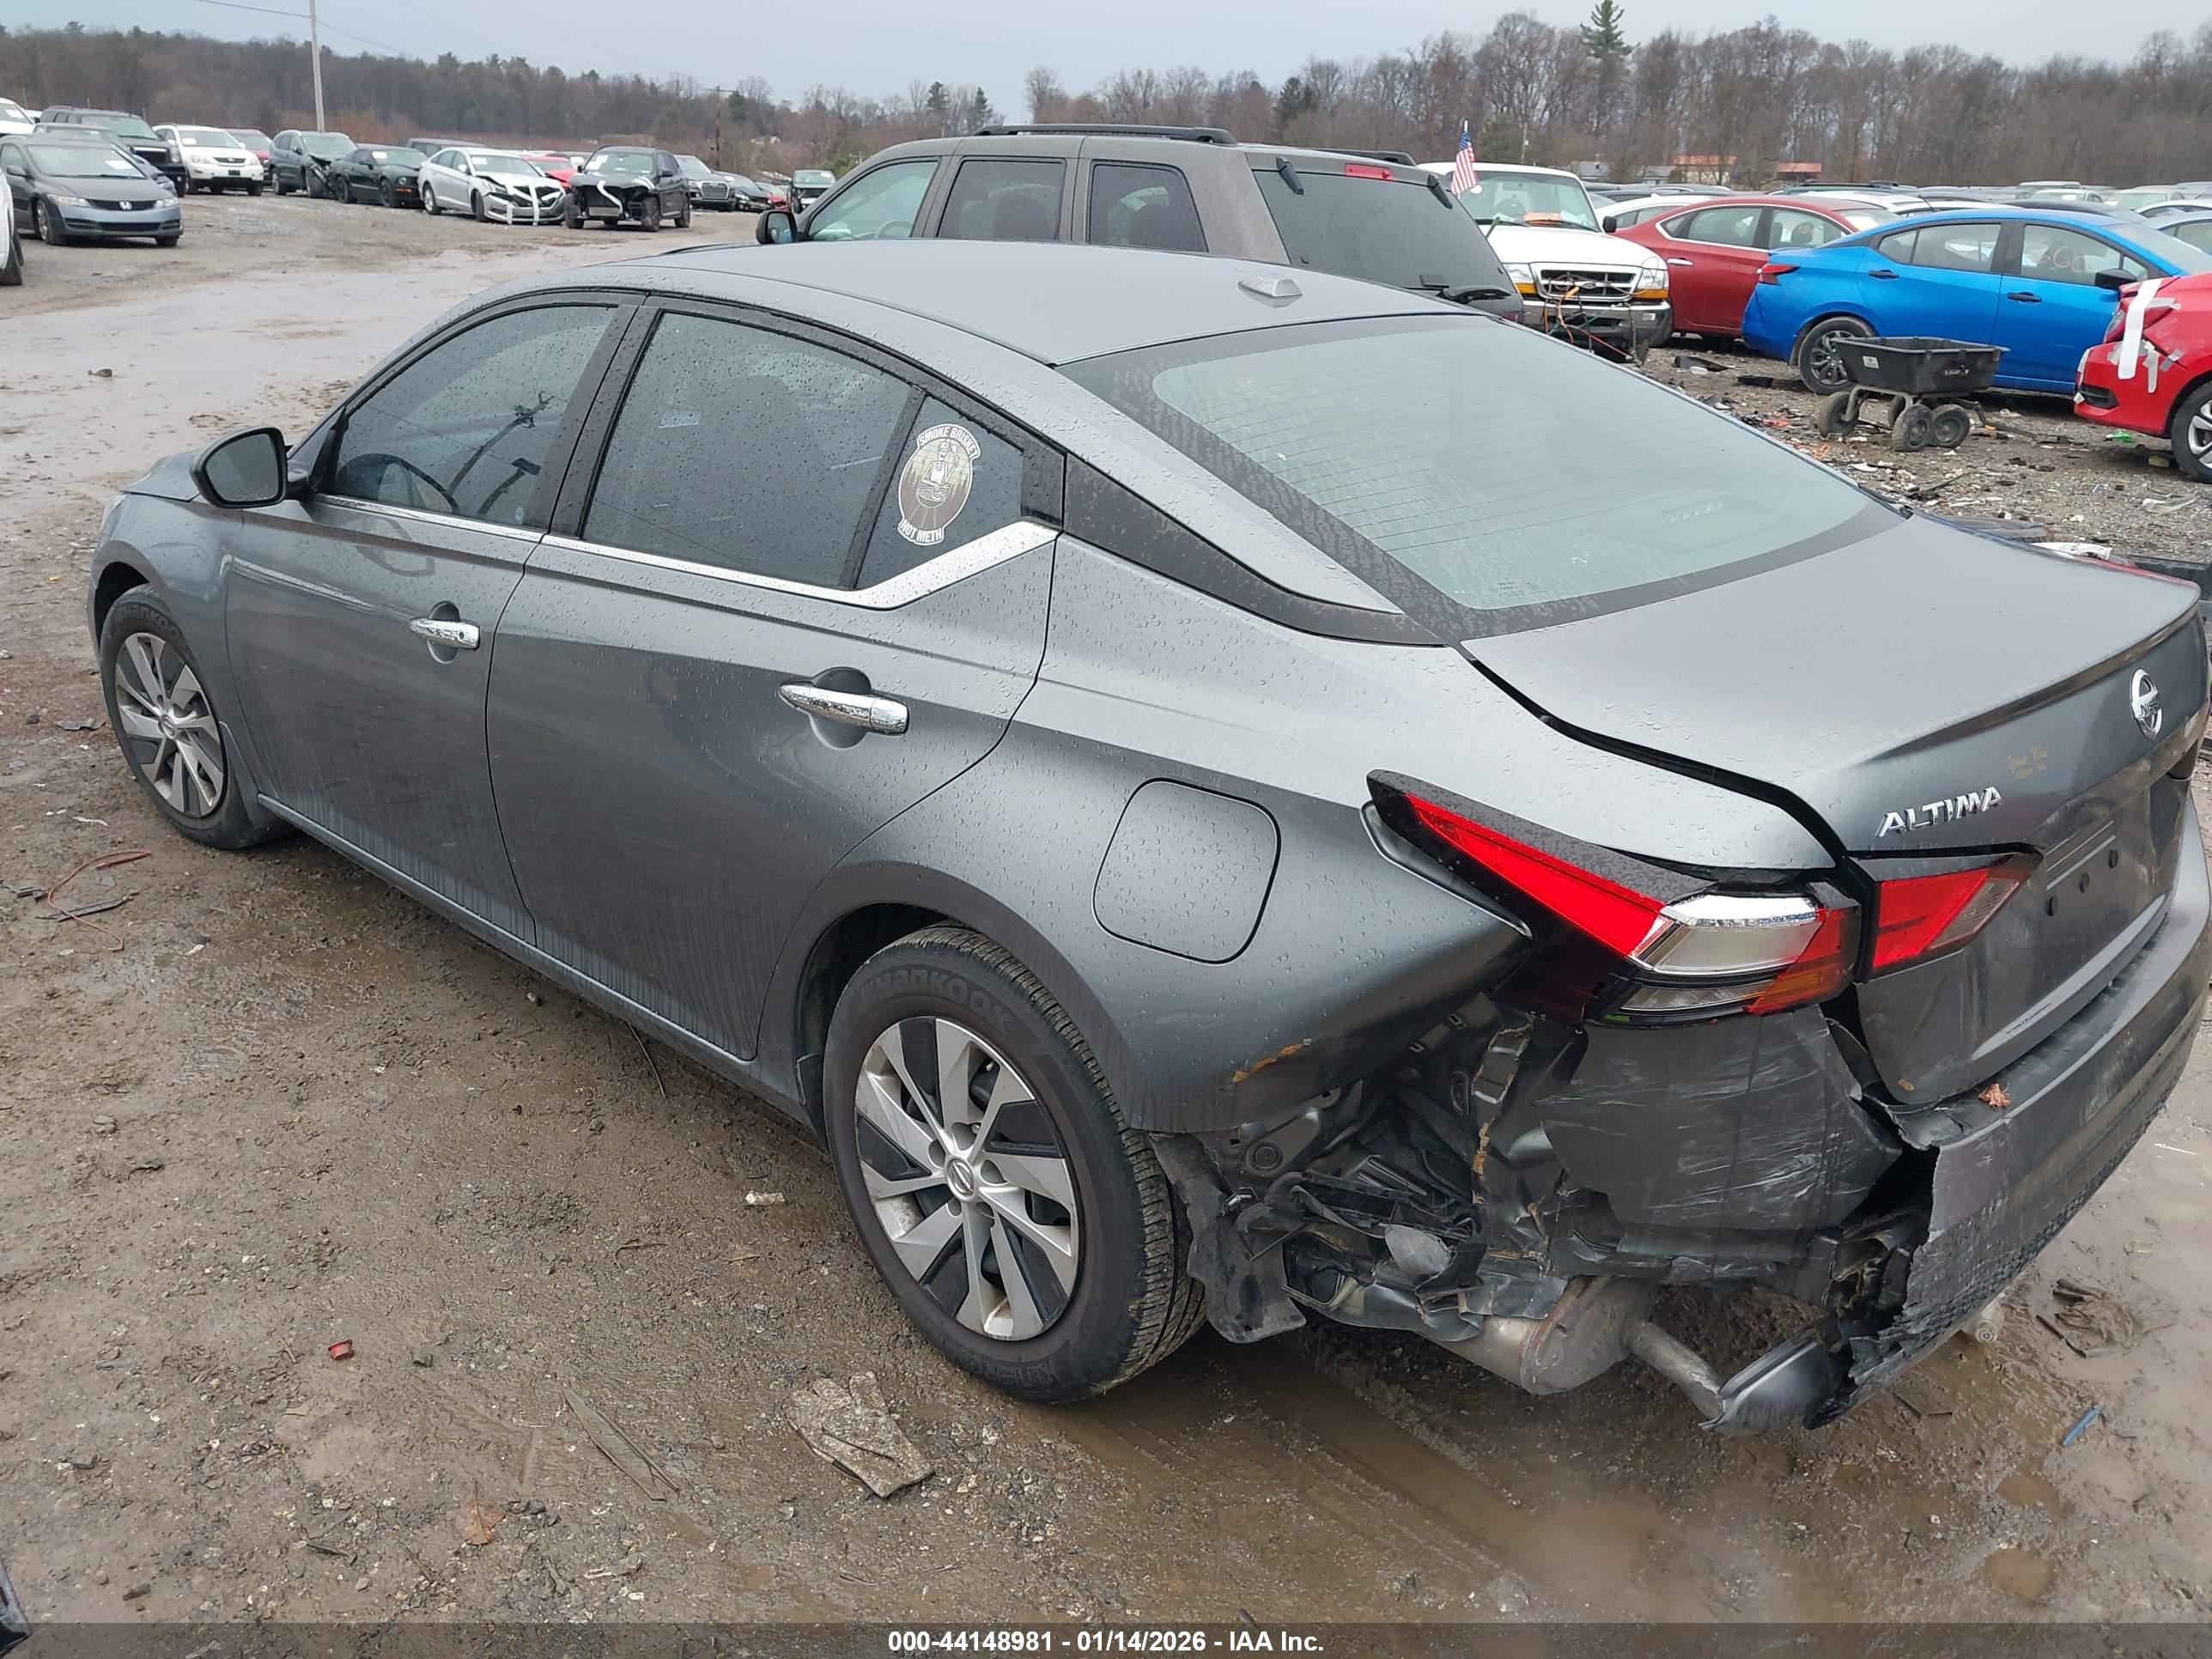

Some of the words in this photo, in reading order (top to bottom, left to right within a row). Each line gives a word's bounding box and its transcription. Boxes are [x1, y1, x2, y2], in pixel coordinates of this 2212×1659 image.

[919, 426, 951, 447] SMOKE
[949, 426, 979, 459] BRISKET
[899, 518, 919, 539] NOT
[915, 527, 942, 544] METH
[1875, 786, 2005, 838] ALTIMA
